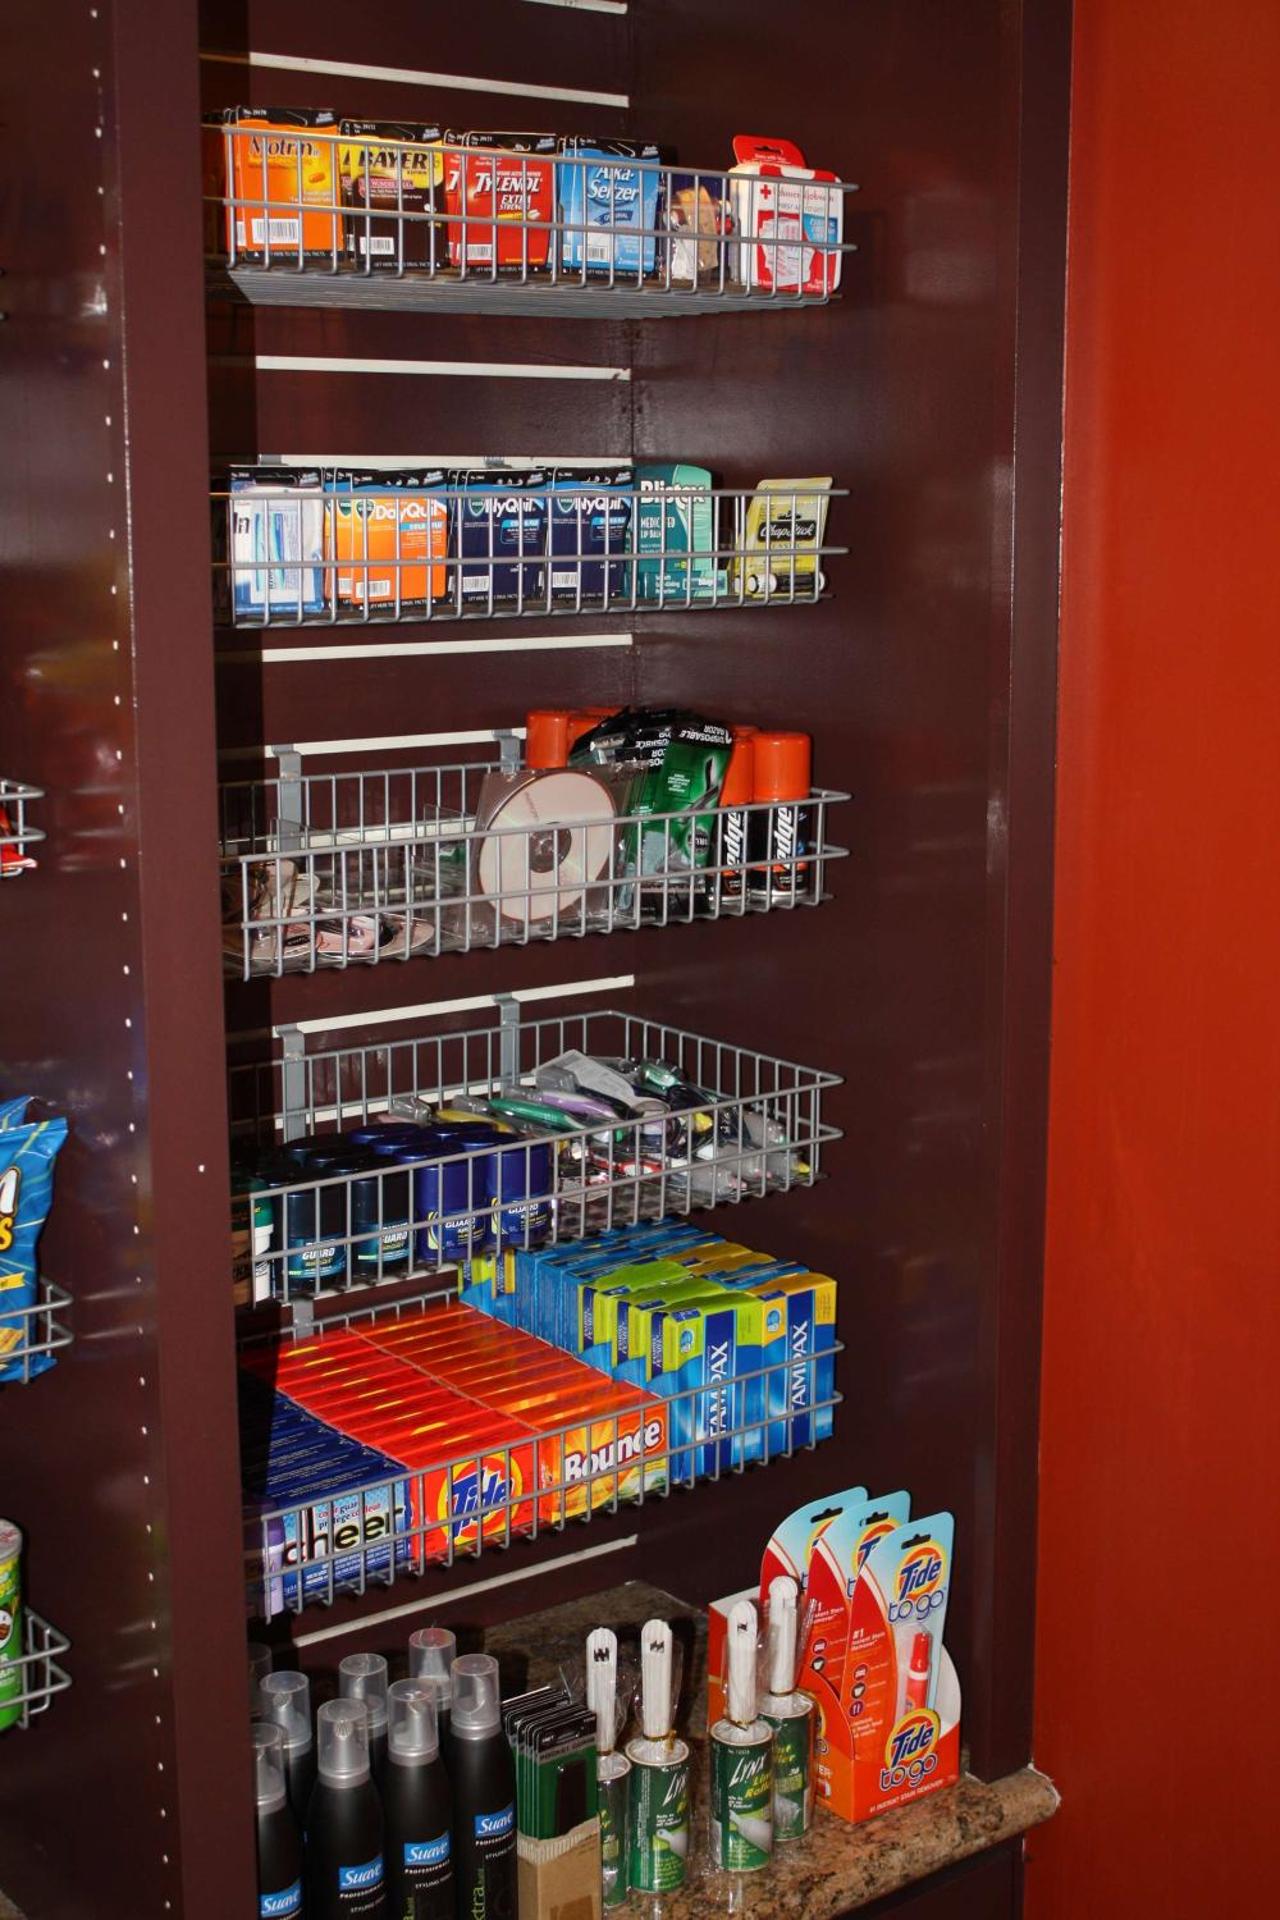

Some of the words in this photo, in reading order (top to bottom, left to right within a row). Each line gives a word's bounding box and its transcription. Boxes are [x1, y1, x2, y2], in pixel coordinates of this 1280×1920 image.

[250, 136, 314, 158] Motrn
[358, 150, 429, 170] BAYER
[587, 179, 640, 202] Selzer
[485, 496, 533, 518] NyQil
[383, 1230, 408, 1244] UARD
[709, 1341, 729, 1443] TAMPAX
[564, 1421, 661, 1482] Bounce
[452, 1468, 515, 1539] Tide
[899, 1557, 943, 1601] Tide
[888, 1600, 913, 1623] to
[916, 1589, 945, 1621] go
[890, 1722, 935, 1769] Tide
[880, 1766, 906, 1792] to
[909, 1754, 938, 1788] go
[478, 1811, 513, 1834] Suave
[407, 1842, 448, 1863] Suave
[341, 1863, 382, 1886] Suave
[261, 1888, 299, 1914] Suave
